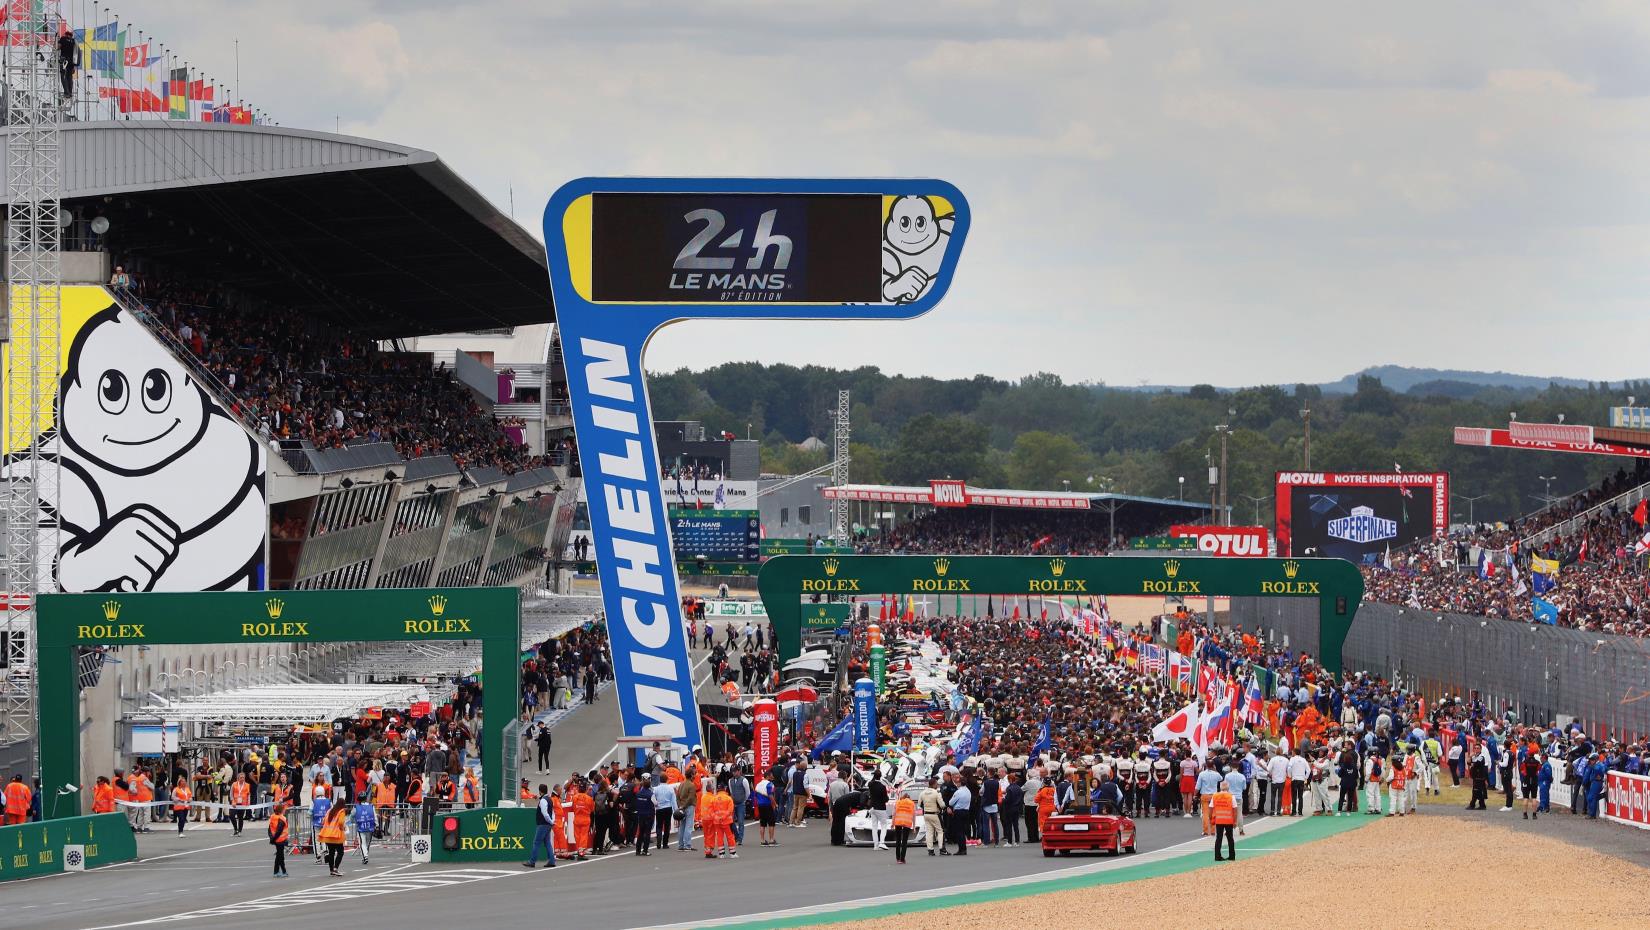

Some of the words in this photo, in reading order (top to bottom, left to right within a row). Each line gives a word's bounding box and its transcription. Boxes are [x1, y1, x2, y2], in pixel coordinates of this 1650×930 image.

[673, 208, 793, 270] 24h
[669, 273, 702, 289] LE
[707, 273, 785, 289] MANS
[738, 290, 782, 300] ÉDITION
[1279, 472, 1326, 484] MOTUL
[1334, 475, 1367, 483] NOTRE
[1369, 475, 1433, 484] INSPIRATION
[691, 487, 714, 496] Cnter
[727, 487, 747, 496] Mans
[934, 484, 966, 503] MOTUL
[1436, 475, 1444, 525] DEMARRE
[1329, 516, 1396, 540] SUPERFINALE
[580, 337, 691, 757] MICHELIN
[802, 579, 861, 591] ROLEX
[913, 579, 970, 591] ROLEX
[1029, 579, 1087, 591] ROLEX
[1143, 580, 1201, 592] ROLEX
[1262, 581, 1320, 593] ROLEX
[78, 624, 145, 639] ROLEX
[241, 622, 309, 636] ROLEX
[404, 618, 472, 633] ROLEX
[808, 617, 837, 625] ROLEX
[860, 701, 868, 735] POSITION
[761, 727, 770, 767] POSITION
[461, 836, 525, 850] ROLEX
[14, 854, 28, 868] ROLEX
[39, 850, 53, 864] ROLEX
